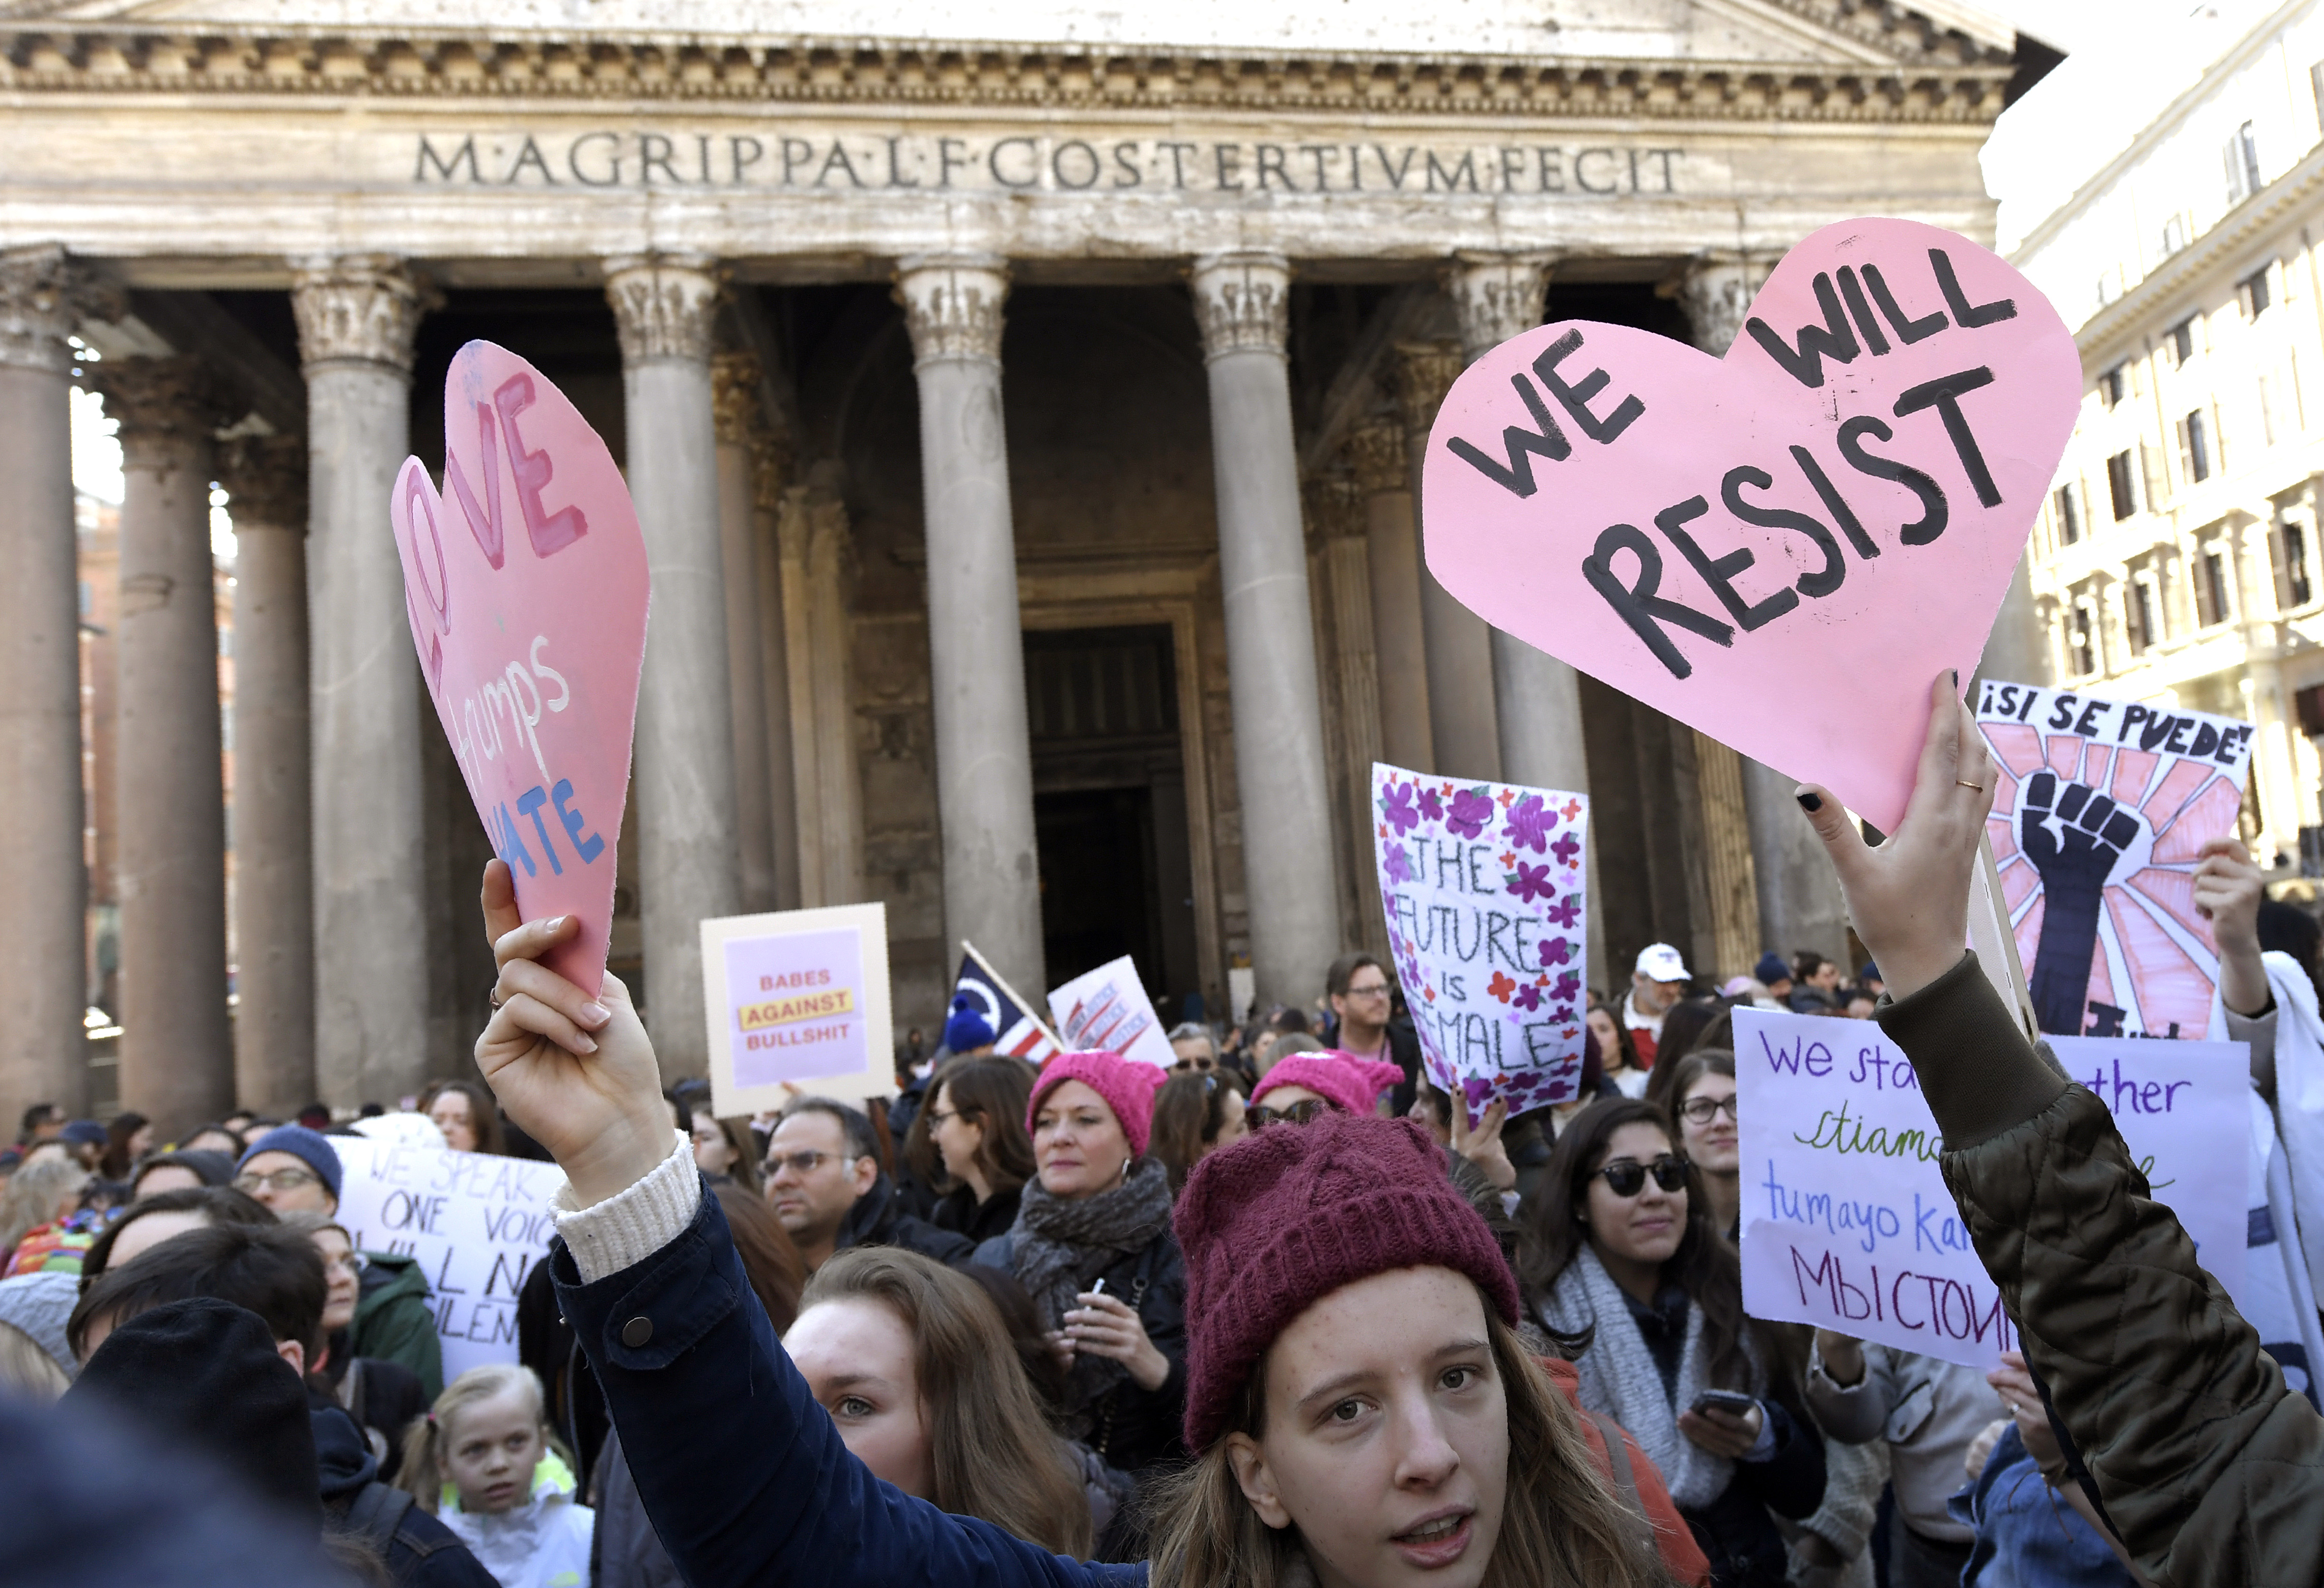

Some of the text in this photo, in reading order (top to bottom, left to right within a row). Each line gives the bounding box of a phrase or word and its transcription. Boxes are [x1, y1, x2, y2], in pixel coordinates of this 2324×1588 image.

[1446, 248, 2018, 499] WE WILL
[1581, 364, 2004, 680] RESIST
[2048, 694, 2111, 738] SE
[2117, 704, 2255, 764] PUEDE!
[1411, 836, 1495, 895] THE
[1395, 893, 1544, 974] FUTURE
[747, 990, 849, 1025] AGAINST
[759, 968, 831, 992] BABES
[1441, 971, 1467, 1002] IS
[747, 1023, 850, 1052] BULLSHIT
[1759, 1030, 1833, 1077] We
[2073, 1058, 2192, 1115] ther
[430, 1149, 539, 1202] SPEAK
[381, 1188, 449, 1237] ONE
[1762, 1158, 1900, 1253] tumayo
